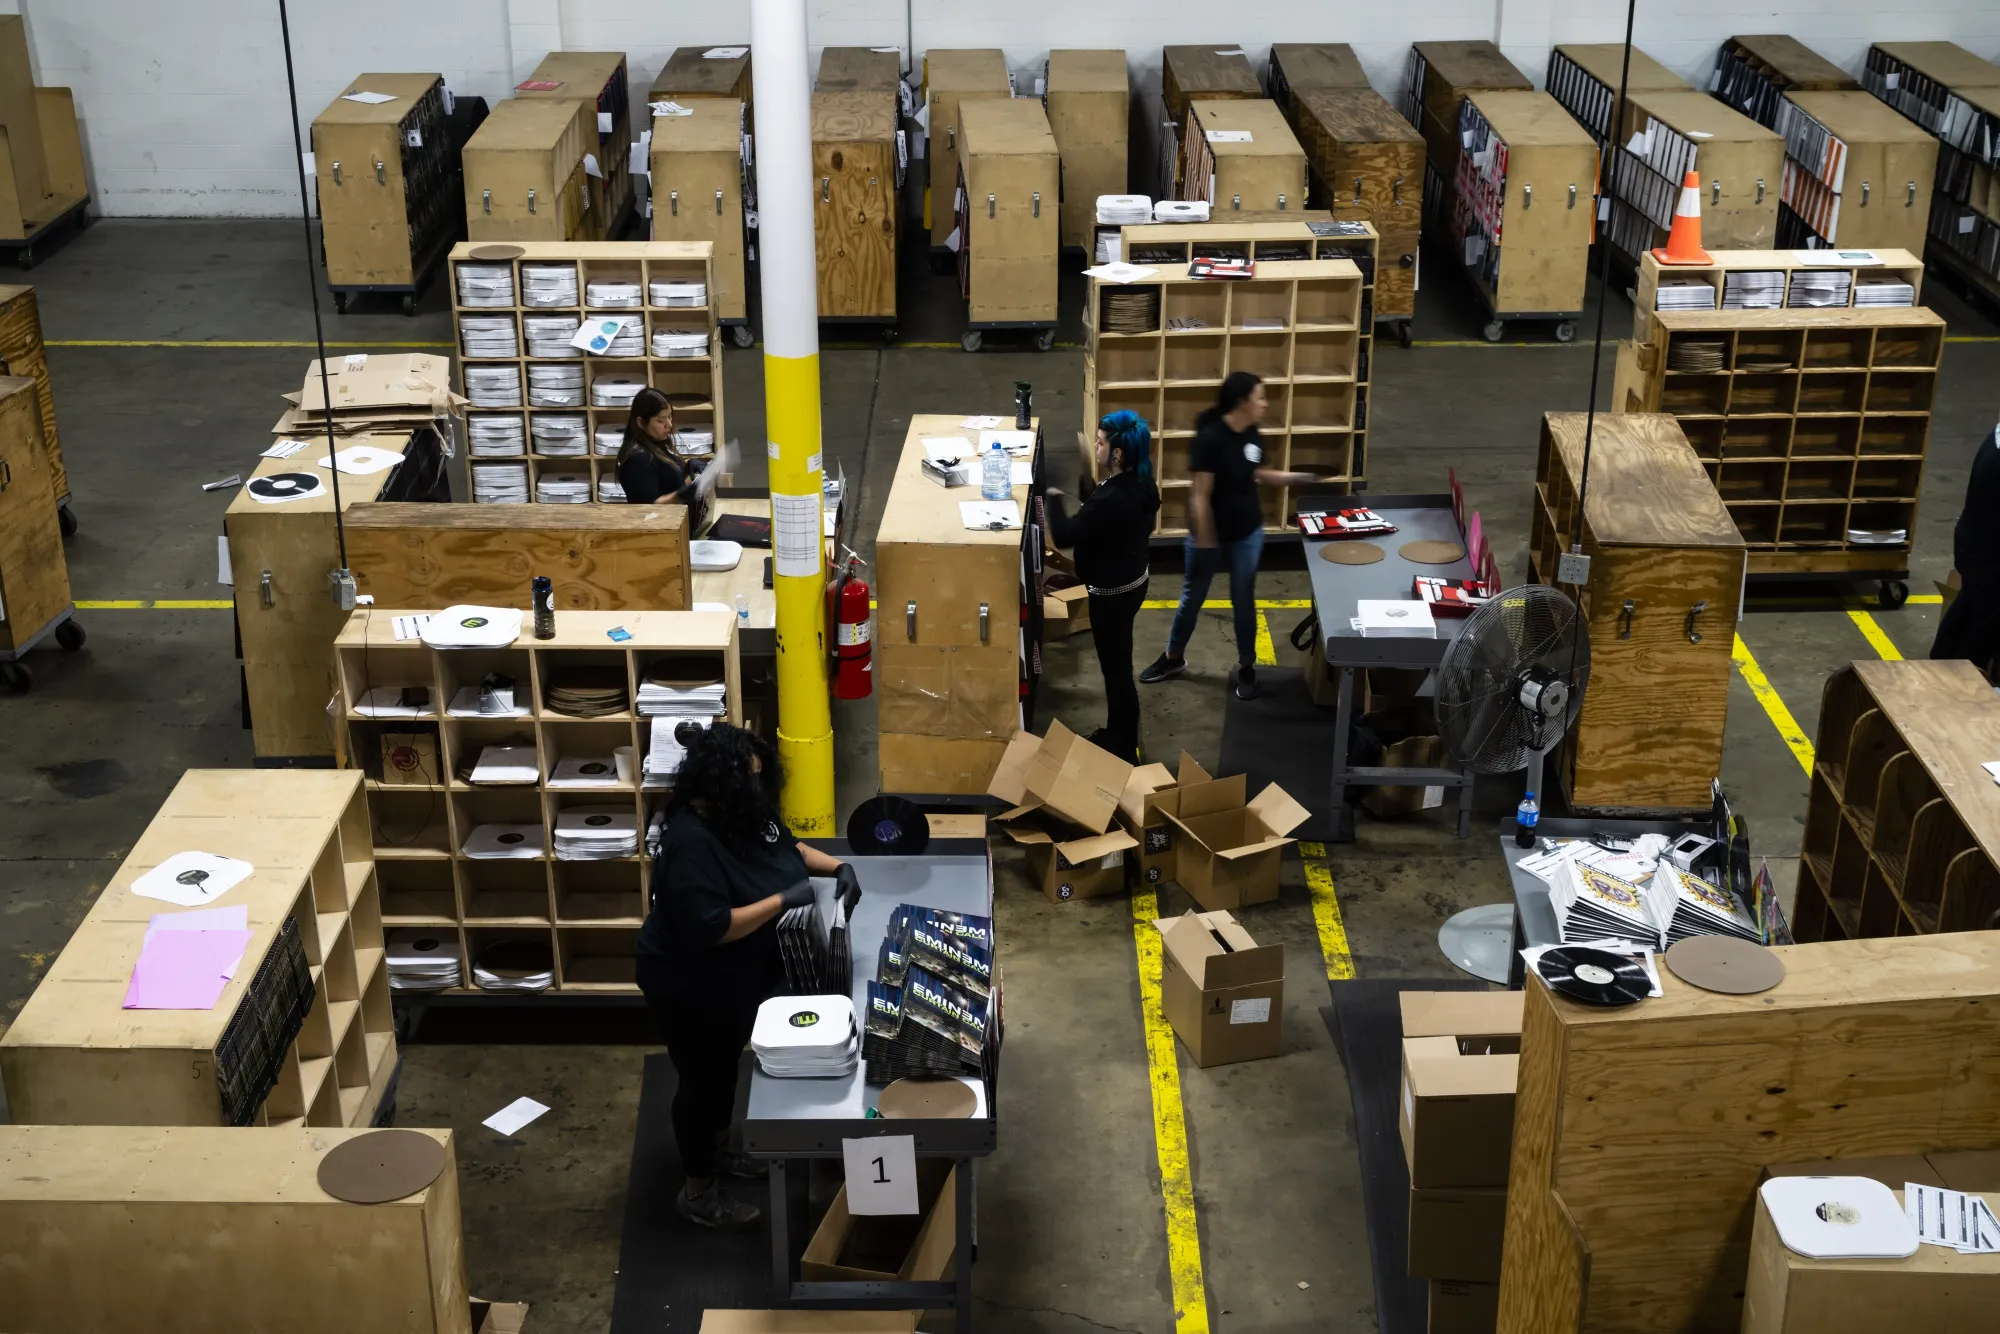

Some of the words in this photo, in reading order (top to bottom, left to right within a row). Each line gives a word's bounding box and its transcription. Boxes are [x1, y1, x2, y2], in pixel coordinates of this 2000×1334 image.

[915, 936, 961, 964] CURTAIN
[912, 989, 960, 1019] CURTAIN
[192, 1060, 208, 1079] 5
[872, 1156, 891, 1183] 1
